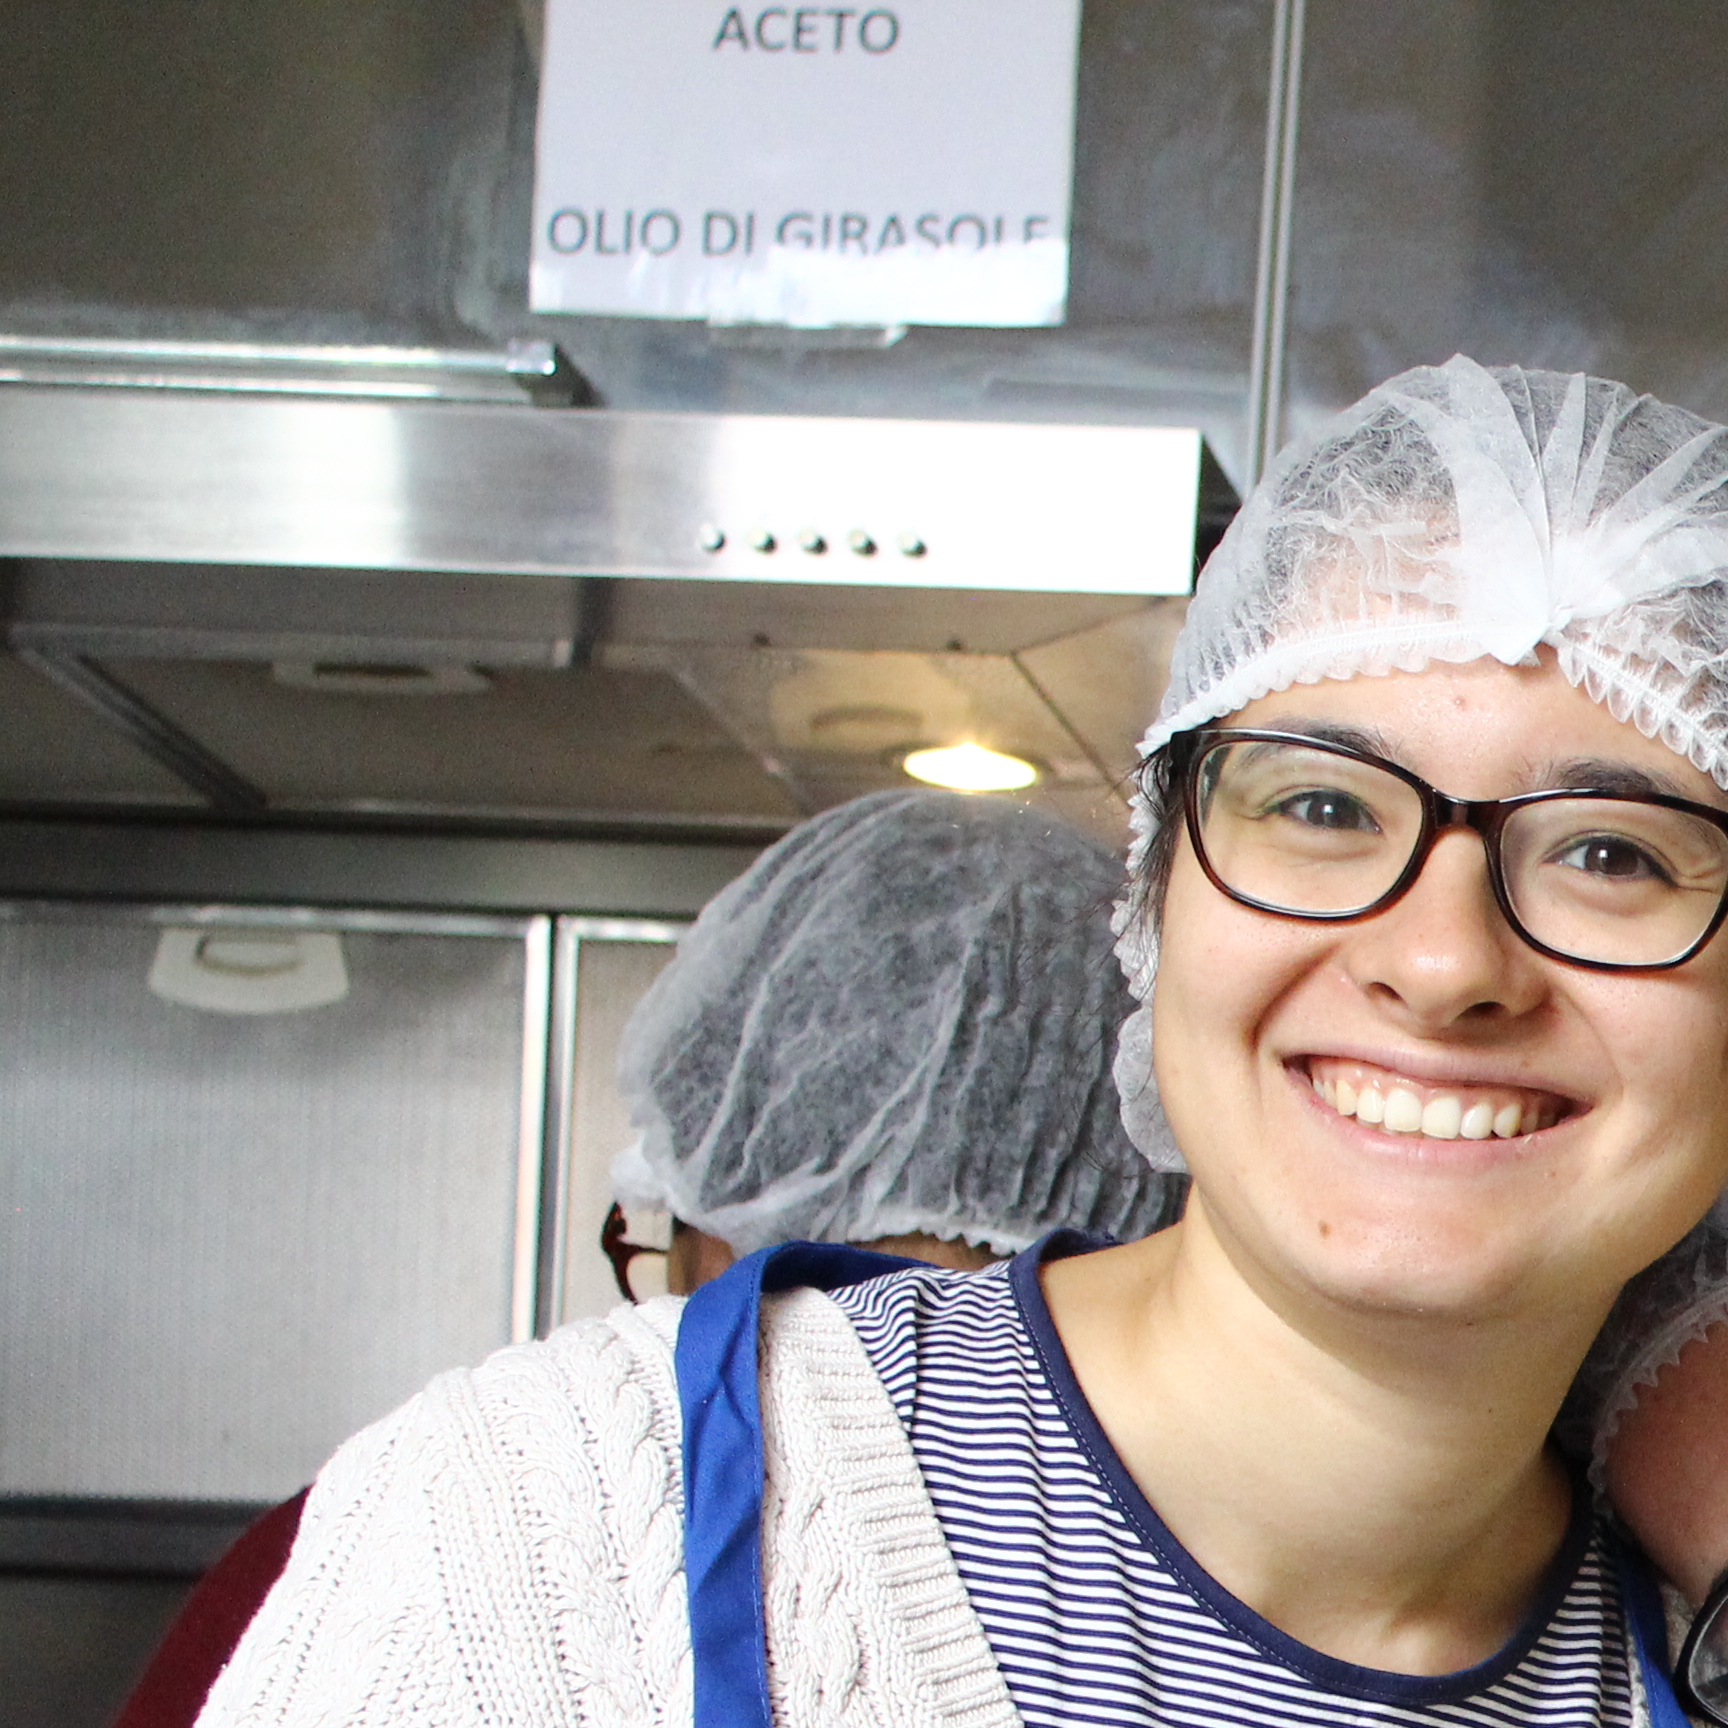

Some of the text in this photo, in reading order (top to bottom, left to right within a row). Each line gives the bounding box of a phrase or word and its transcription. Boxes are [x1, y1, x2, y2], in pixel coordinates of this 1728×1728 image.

[712, 7, 900, 54] ACETO
[546, 209, 682, 256] OLIO
[703, 211, 755, 256] DI
